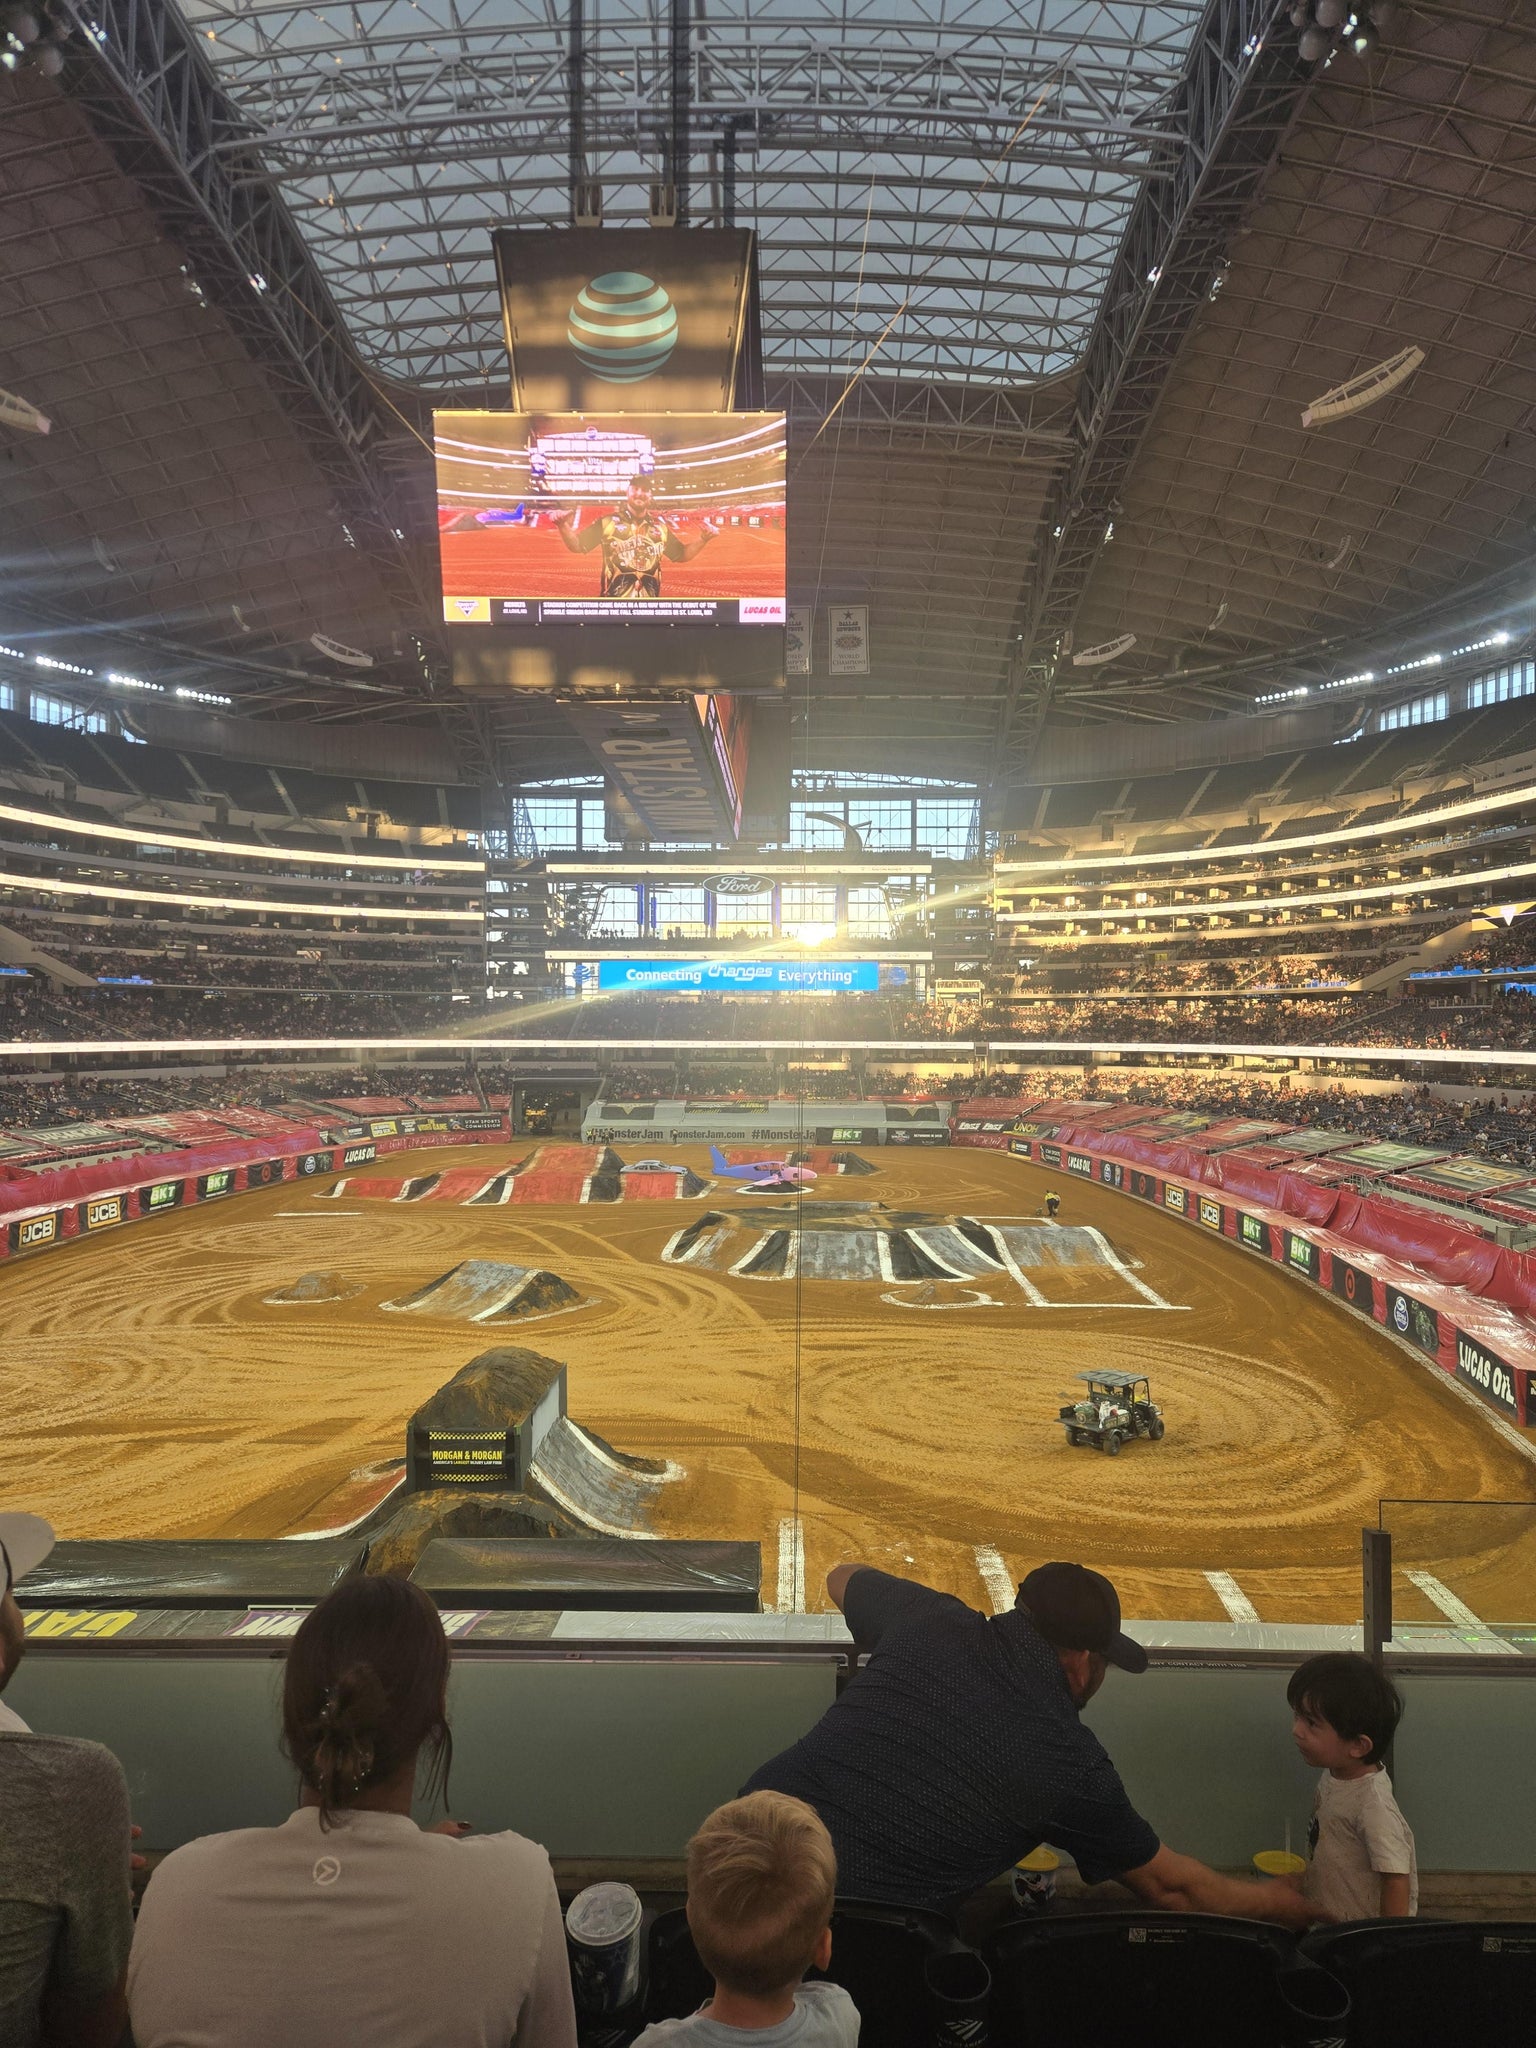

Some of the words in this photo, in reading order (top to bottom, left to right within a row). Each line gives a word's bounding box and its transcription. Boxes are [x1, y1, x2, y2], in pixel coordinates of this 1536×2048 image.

[512, 687, 732, 695] WINSTAR
[601, 738, 719, 830] WINSTAR
[716, 878, 761, 893] Ford
[626, 968, 702, 983] Connecting
[708, 966, 774, 981] Changes
[832, 1129, 863, 1140] BKT
[1013, 1122, 1040, 1133] UNOH
[345, 1148, 366, 1163] LUCAS
[366, 1146, 376, 1159] OIL
[1067, 1156, 1082, 1171] LUCAS
[1082, 1159, 1091, 1174] OIL
[206, 1174, 229, 1193] BKT
[150, 1185, 176, 1205] BKT
[1167, 1188, 1182, 1207] JCB
[91, 1202, 118, 1223] JCB
[1202, 1203, 1218, 1224] JCB
[22, 1220, 53, 1243] JCB
[1243, 1216, 1261, 1239] BKT
[1290, 1236, 1311, 1264] BKT
[1459, 1341, 1491, 1388] LUCAS
[432, 1450, 463, 1460] MORGAN
[464, 1450, 470, 1460] &
[472, 1450, 503, 1460] MORGAN
